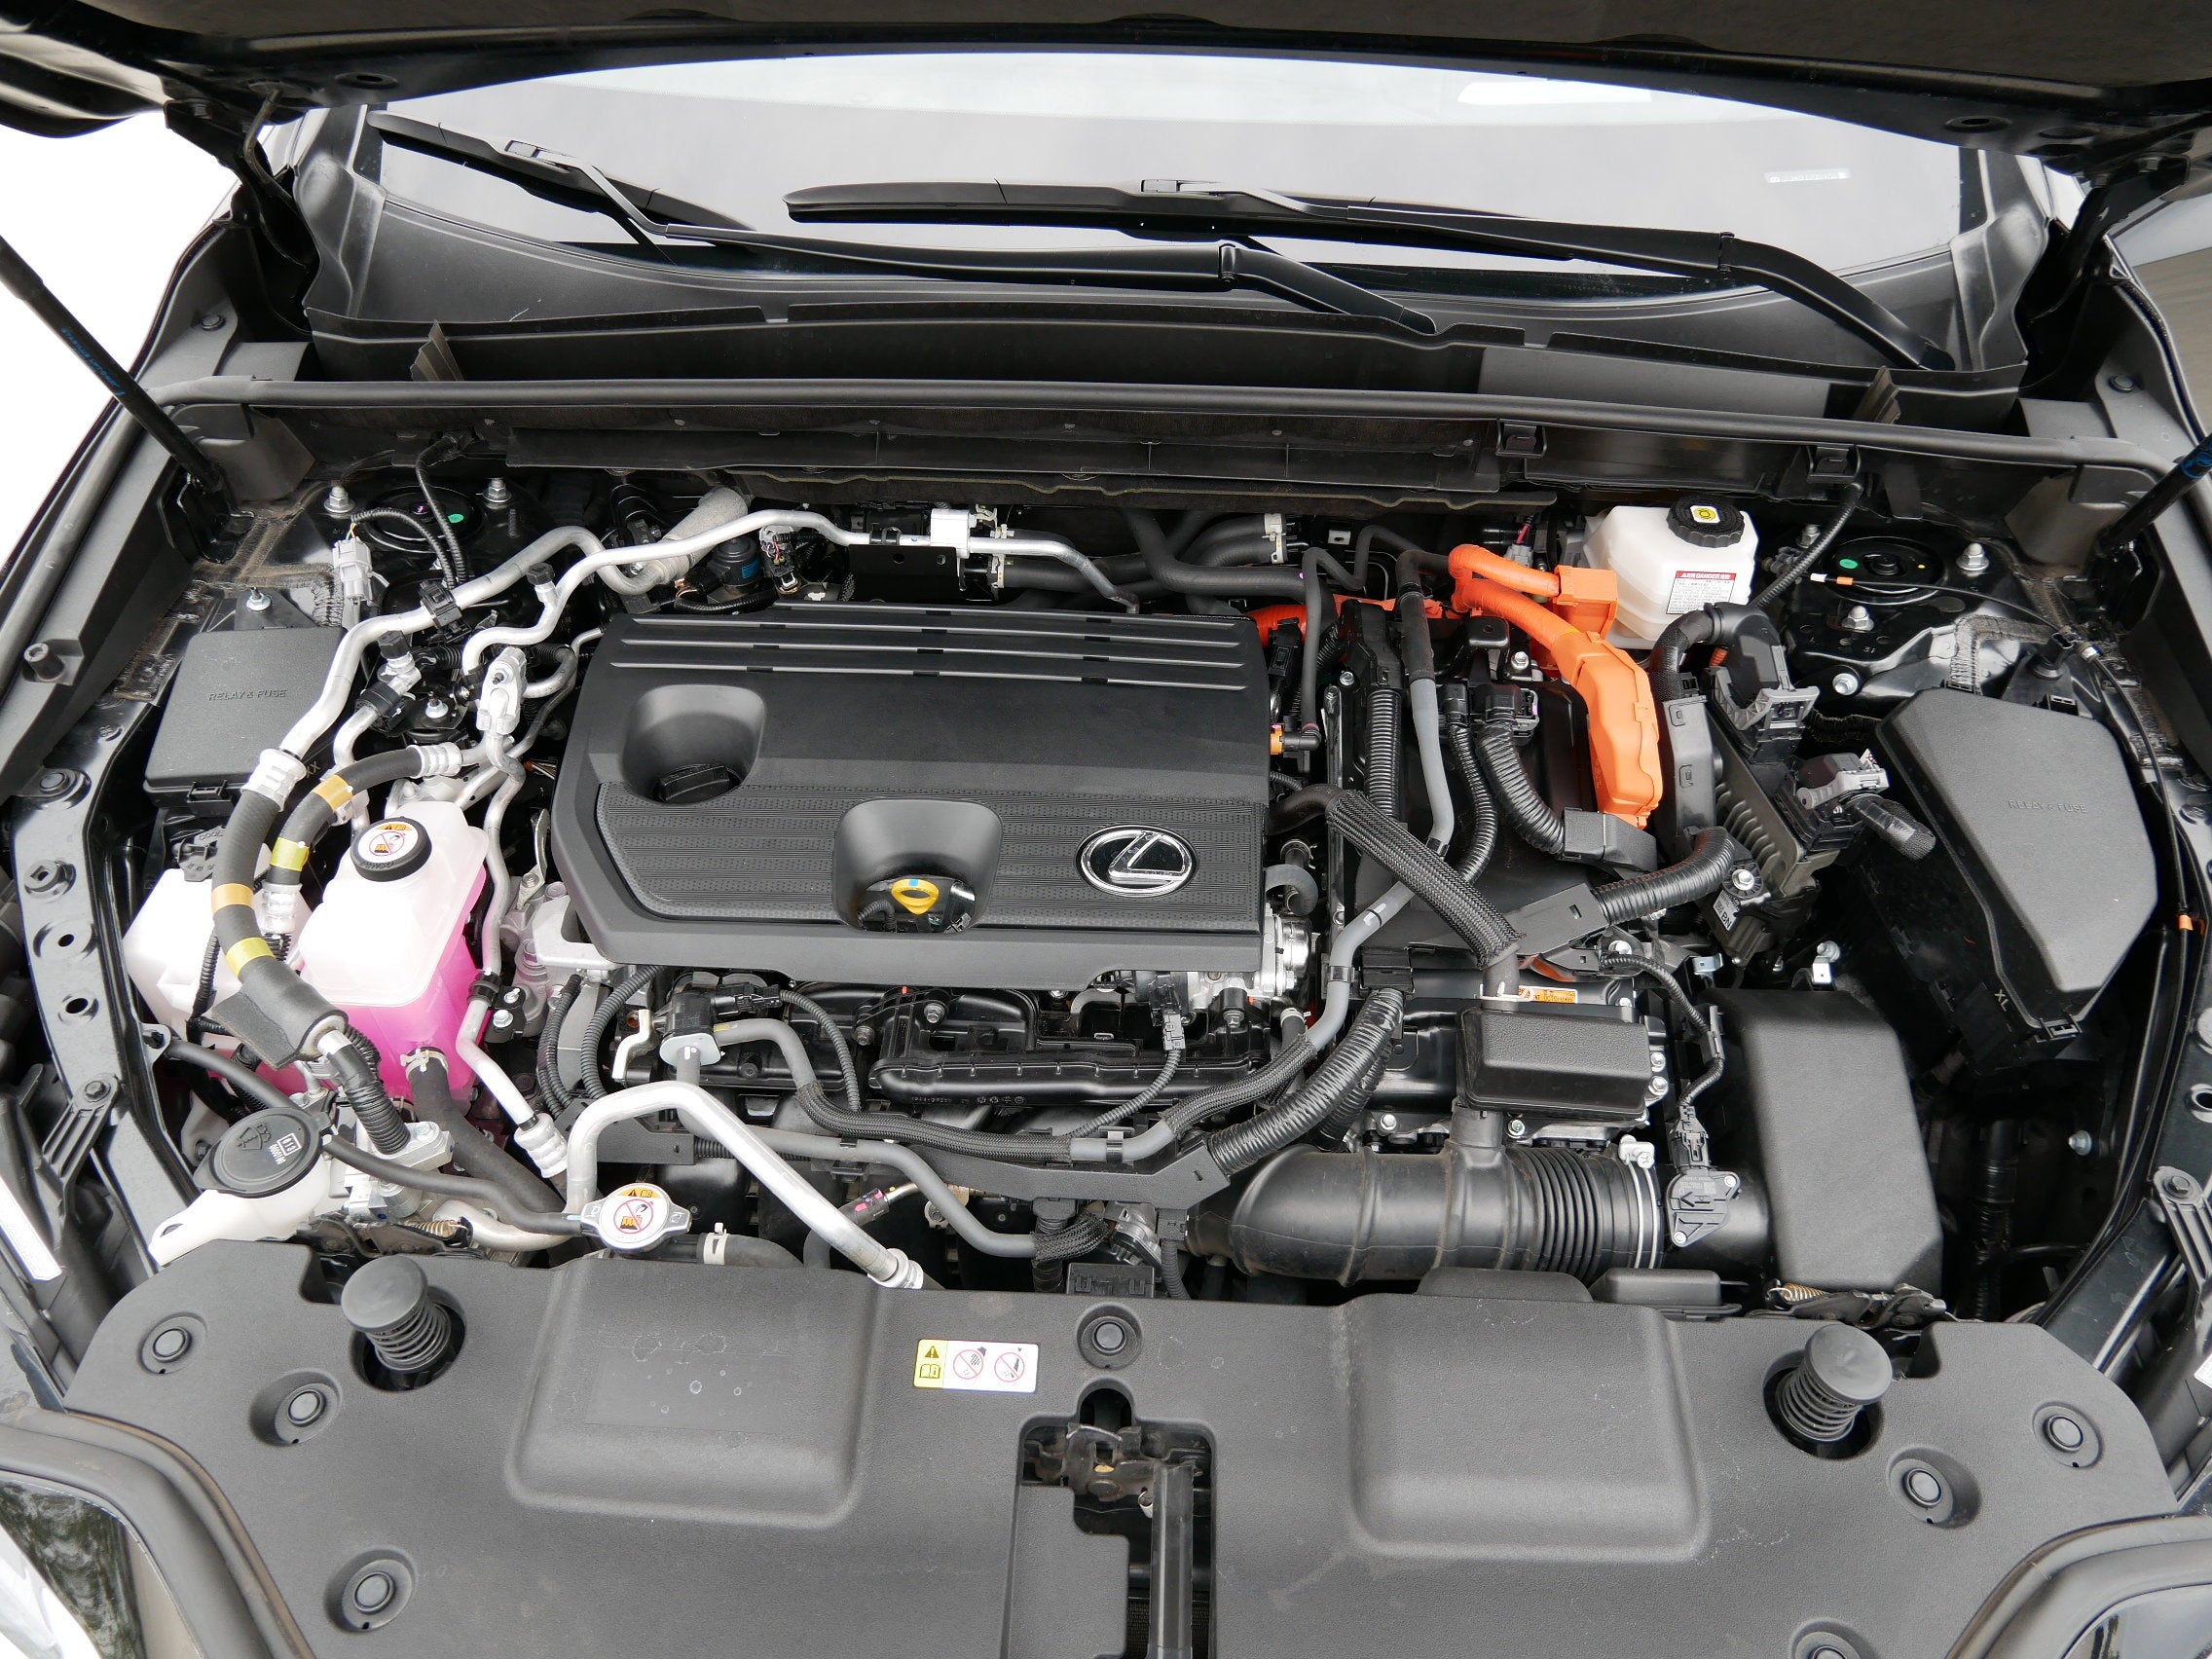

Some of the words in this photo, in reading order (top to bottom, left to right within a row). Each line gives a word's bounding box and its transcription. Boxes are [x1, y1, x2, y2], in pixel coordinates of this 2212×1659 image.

[207, 690, 246, 702] RELAY
[256, 688, 288, 699] FUSE
[2008, 798, 2044, 810] RELAY
[2056, 802, 2088, 814] FUSE
